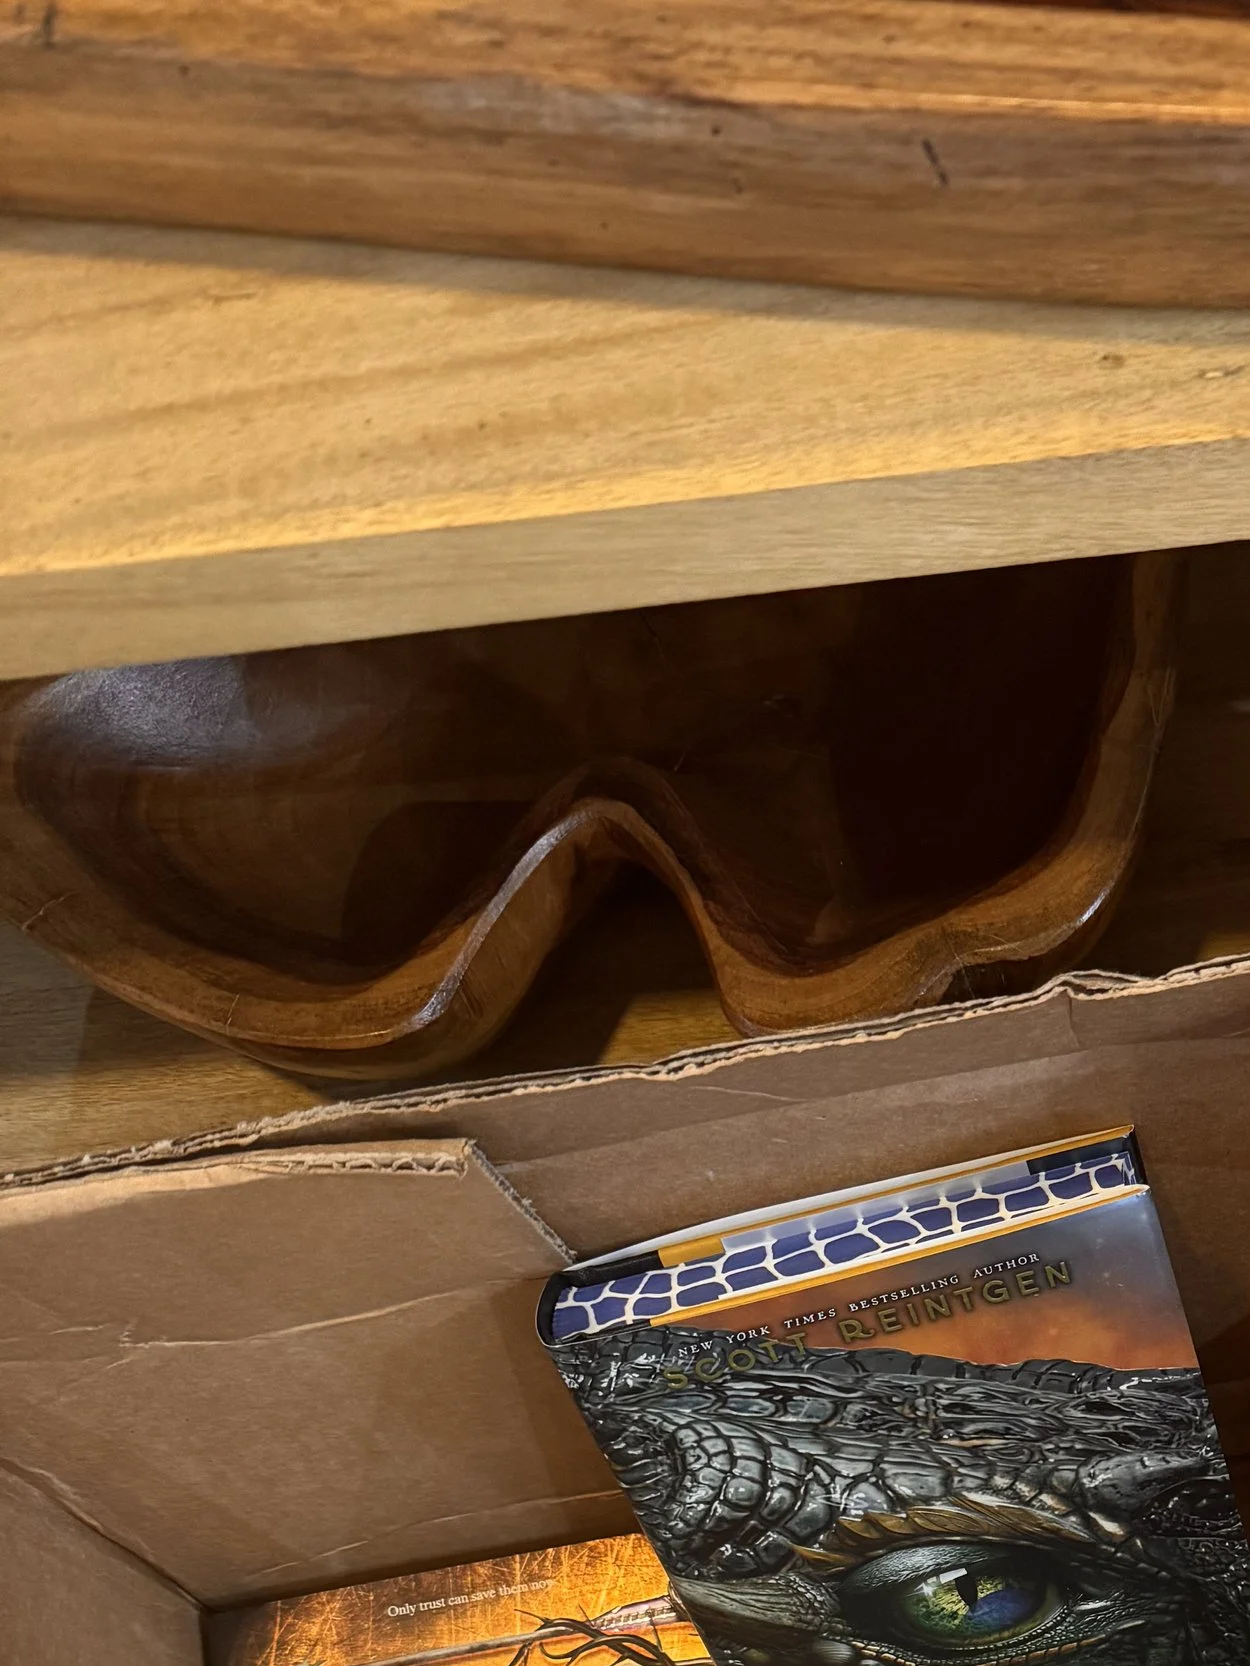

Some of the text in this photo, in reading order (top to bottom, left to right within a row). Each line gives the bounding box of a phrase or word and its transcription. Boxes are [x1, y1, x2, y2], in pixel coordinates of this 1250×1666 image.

[662, 1260, 1073, 1391] SCOTT REINTGEN
[678, 1252, 1041, 1359] NEW YORK TIMES BESTSELLING AUTHOR
[387, 1603, 417, 1618] Only
[419, 1598, 445, 1611] trust
[448, 1594, 469, 1606] can
[471, 1589, 496, 1601] save
[499, 1583, 528, 1596] them
